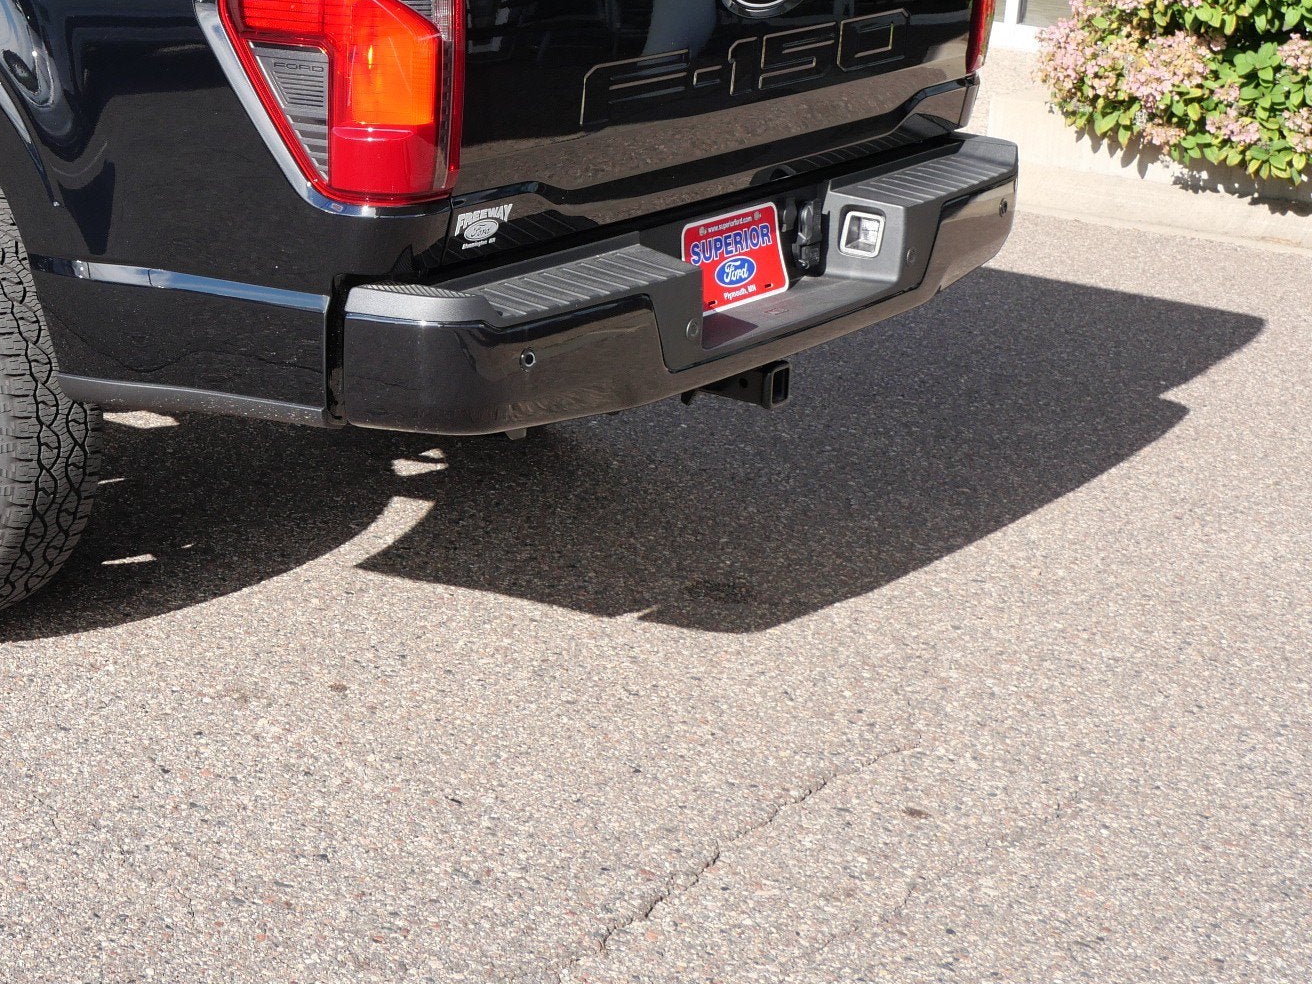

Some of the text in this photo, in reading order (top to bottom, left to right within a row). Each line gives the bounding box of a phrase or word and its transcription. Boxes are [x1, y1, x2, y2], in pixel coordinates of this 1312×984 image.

[273, 61, 325, 73] FORD
[579, 8, 911, 126] F-150
[454, 203, 514, 237] FREEWAY
[690, 222, 773, 266] SUPERIOR
[723, 260, 749, 283] Ford
